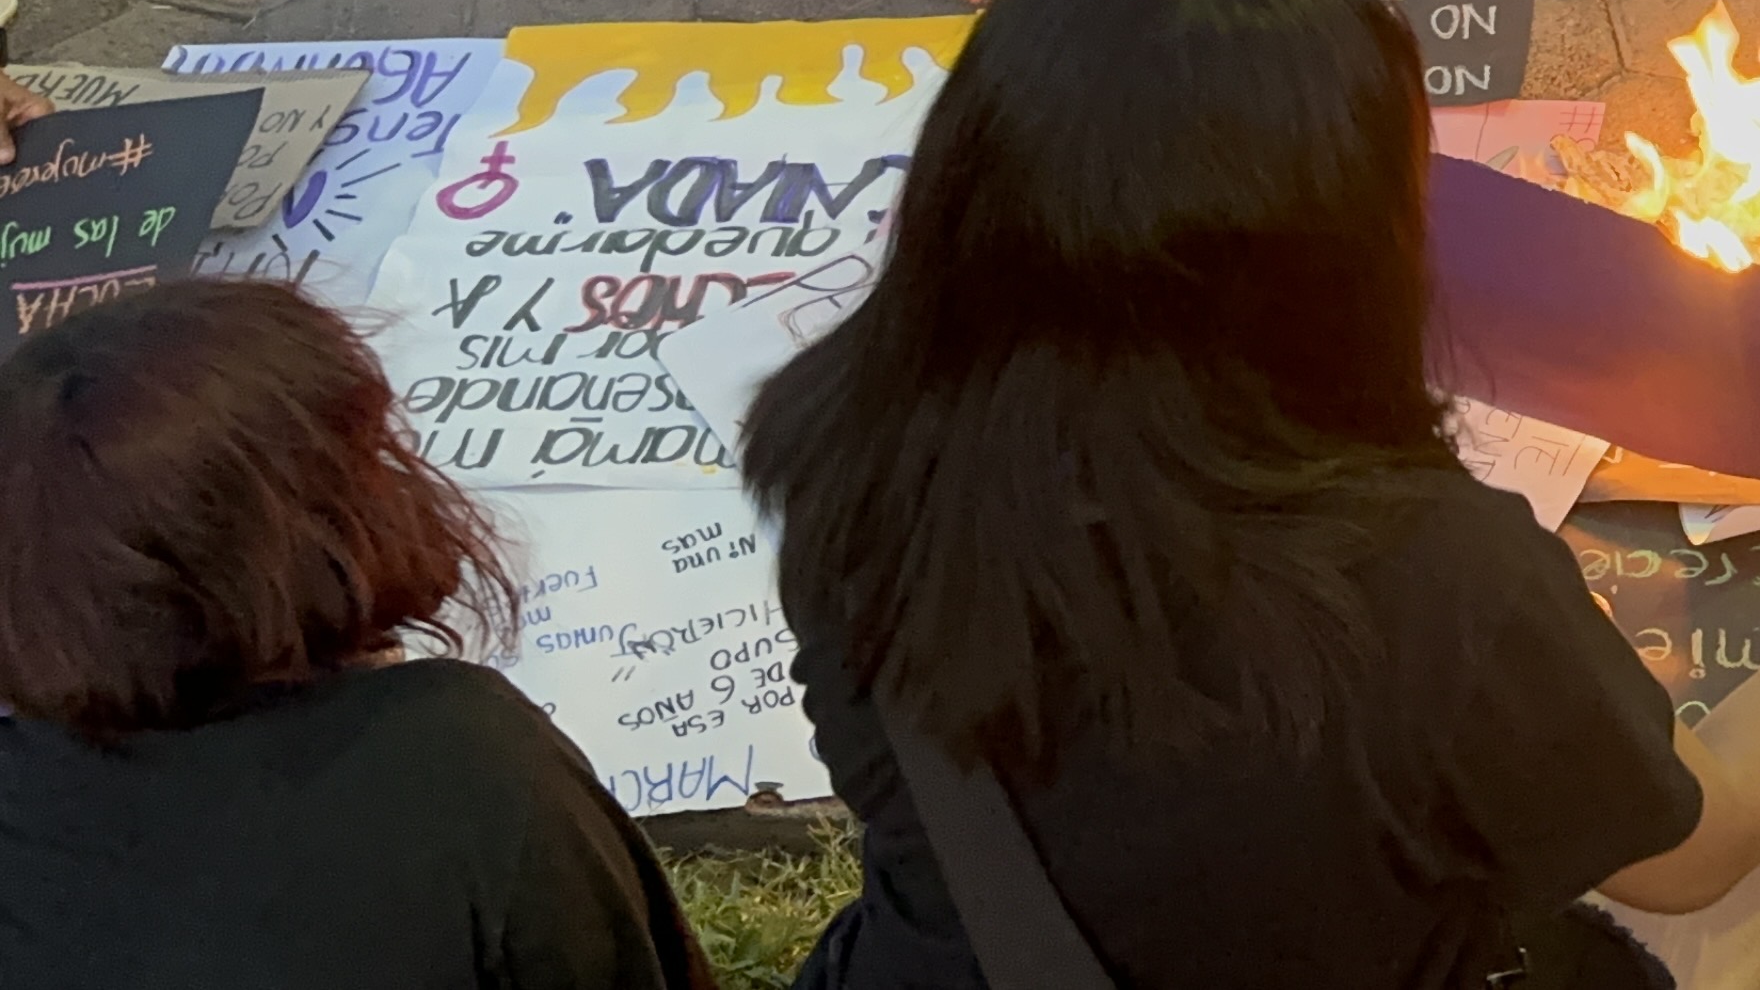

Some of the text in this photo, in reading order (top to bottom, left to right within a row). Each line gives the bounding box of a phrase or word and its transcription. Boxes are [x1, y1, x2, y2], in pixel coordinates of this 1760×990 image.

[1429, 2, 1496, 38] NO
[1424, 64, 1490, 94] NO
[305, 106, 460, 164] Teng
[73, 213, 118, 258] las
[137, 205, 175, 246] de
[463, 208, 841, 272] quedarme
[429, 273, 501, 328] A
[501, 276, 554, 331] Y
[659, 521, 722, 553] mas
[670, 532, 755, 573] Ni una
[616, 659, 784, 730] DE 6 AÑOS
[670, 684, 794, 737] POR ESA
[603, 743, 752, 811] MARC
